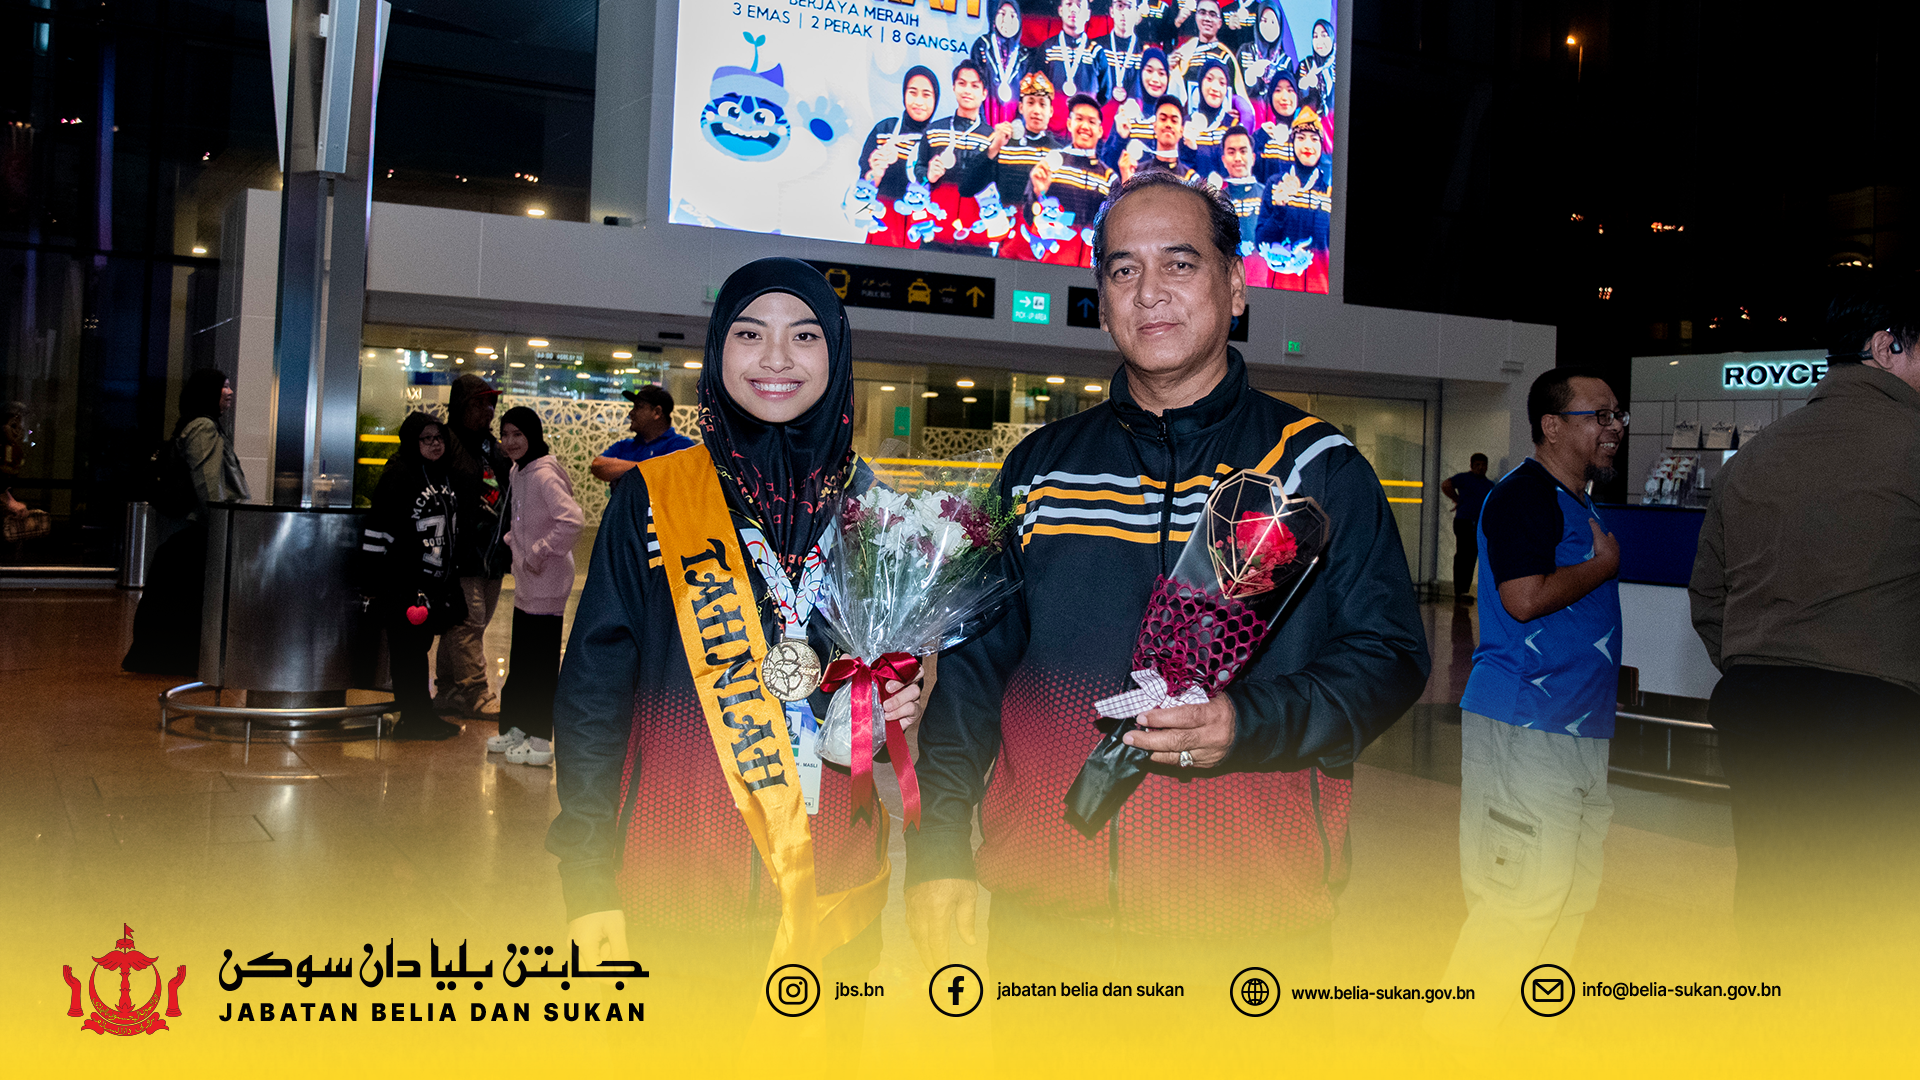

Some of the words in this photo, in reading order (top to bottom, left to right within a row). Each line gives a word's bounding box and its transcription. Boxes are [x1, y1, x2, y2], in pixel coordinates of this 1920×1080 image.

[732, 2, 742, 16] 3
[747, 5, 790, 24] EMAS
[811, 15, 819, 29] 2
[824, 17, 873, 39] PERAK
[892, 30, 901, 43] 8
[905, 34, 969, 55] GANGSA
[864, 5, 919, 27] MERAIH
[1724, 363, 1828, 386] ROYCE
[680, 538, 789, 795] TAHNIAH
